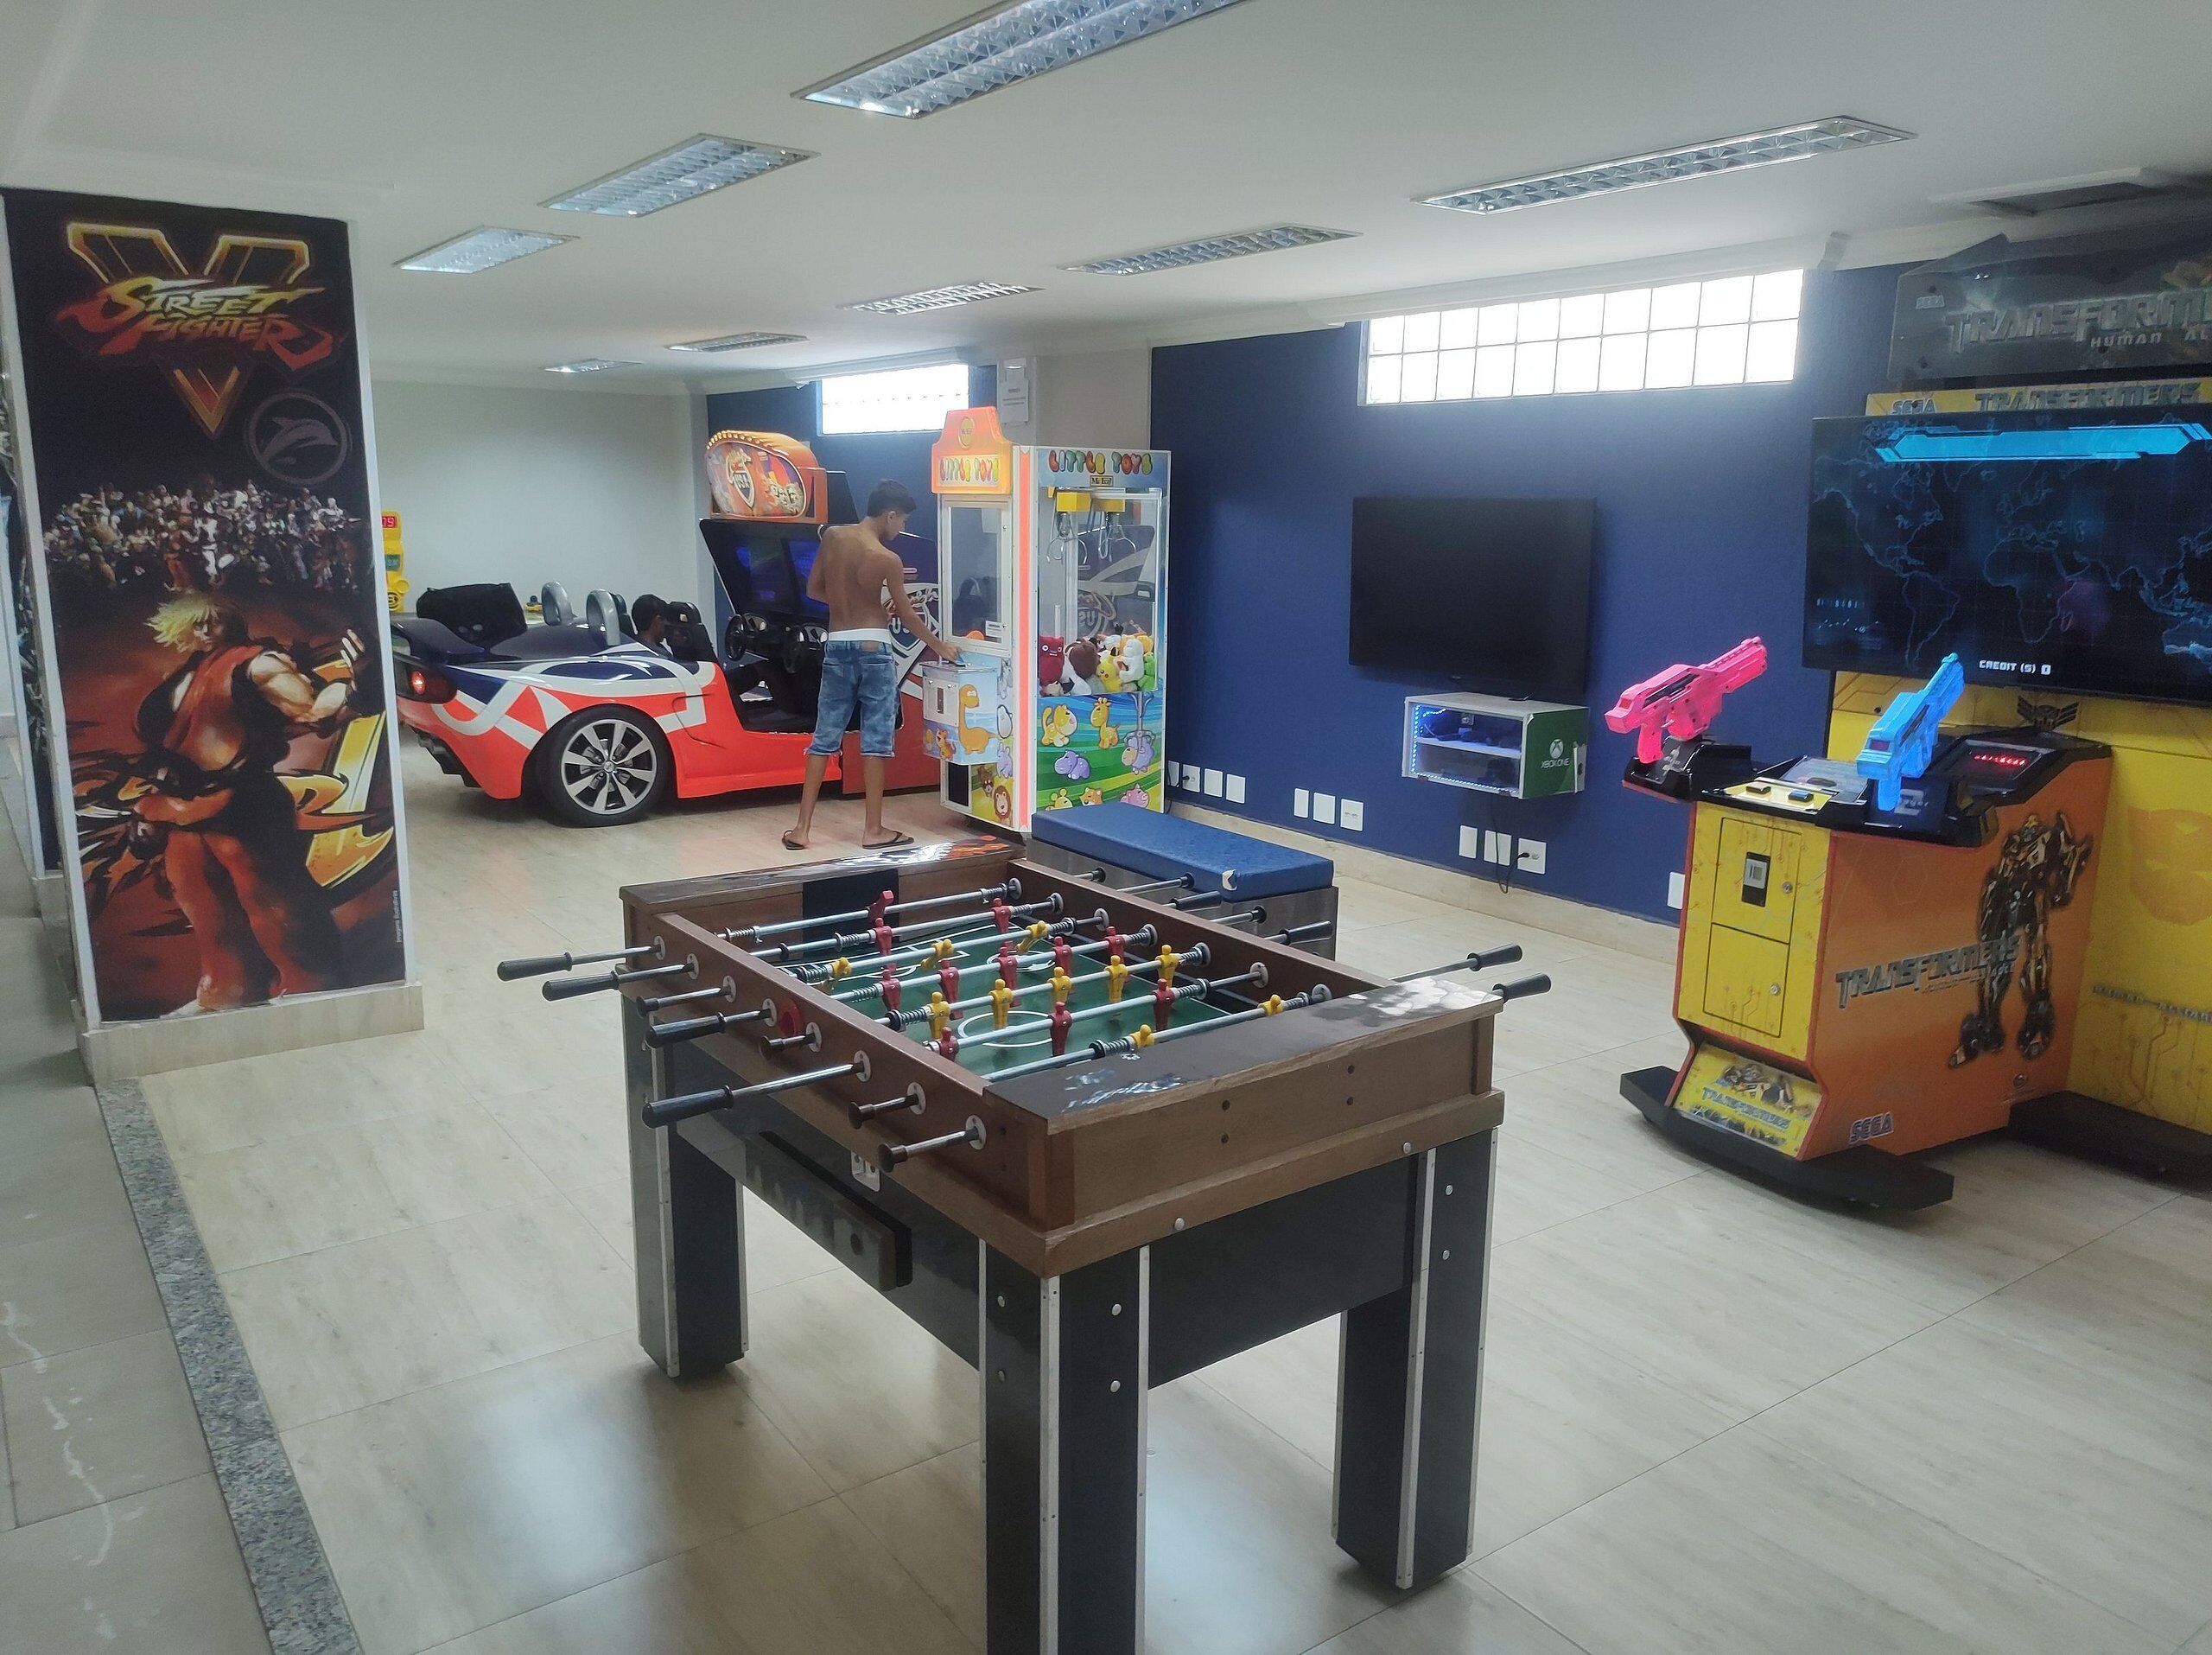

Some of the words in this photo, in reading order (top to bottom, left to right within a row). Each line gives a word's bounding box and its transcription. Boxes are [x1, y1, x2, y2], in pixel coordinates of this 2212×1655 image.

[56, 275, 327, 333] STREET
[1945, 288, 2212, 353] TRANSFORM
[99, 314, 335, 372] FIGHTER
[2090, 331, 2163, 347] HUMAN
[1890, 398, 1938, 415] SEGA
[1974, 381, 2202, 413] TRANSFORMERS
[1048, 449, 1106, 474] LITTLE
[1111, 451, 1153, 475] TOYS
[1979, 659, 2018, 671] CREDIT
[1834, 933, 2023, 1009] TRANSFORMERS
[1848, 1111, 1894, 1144] SEGA
